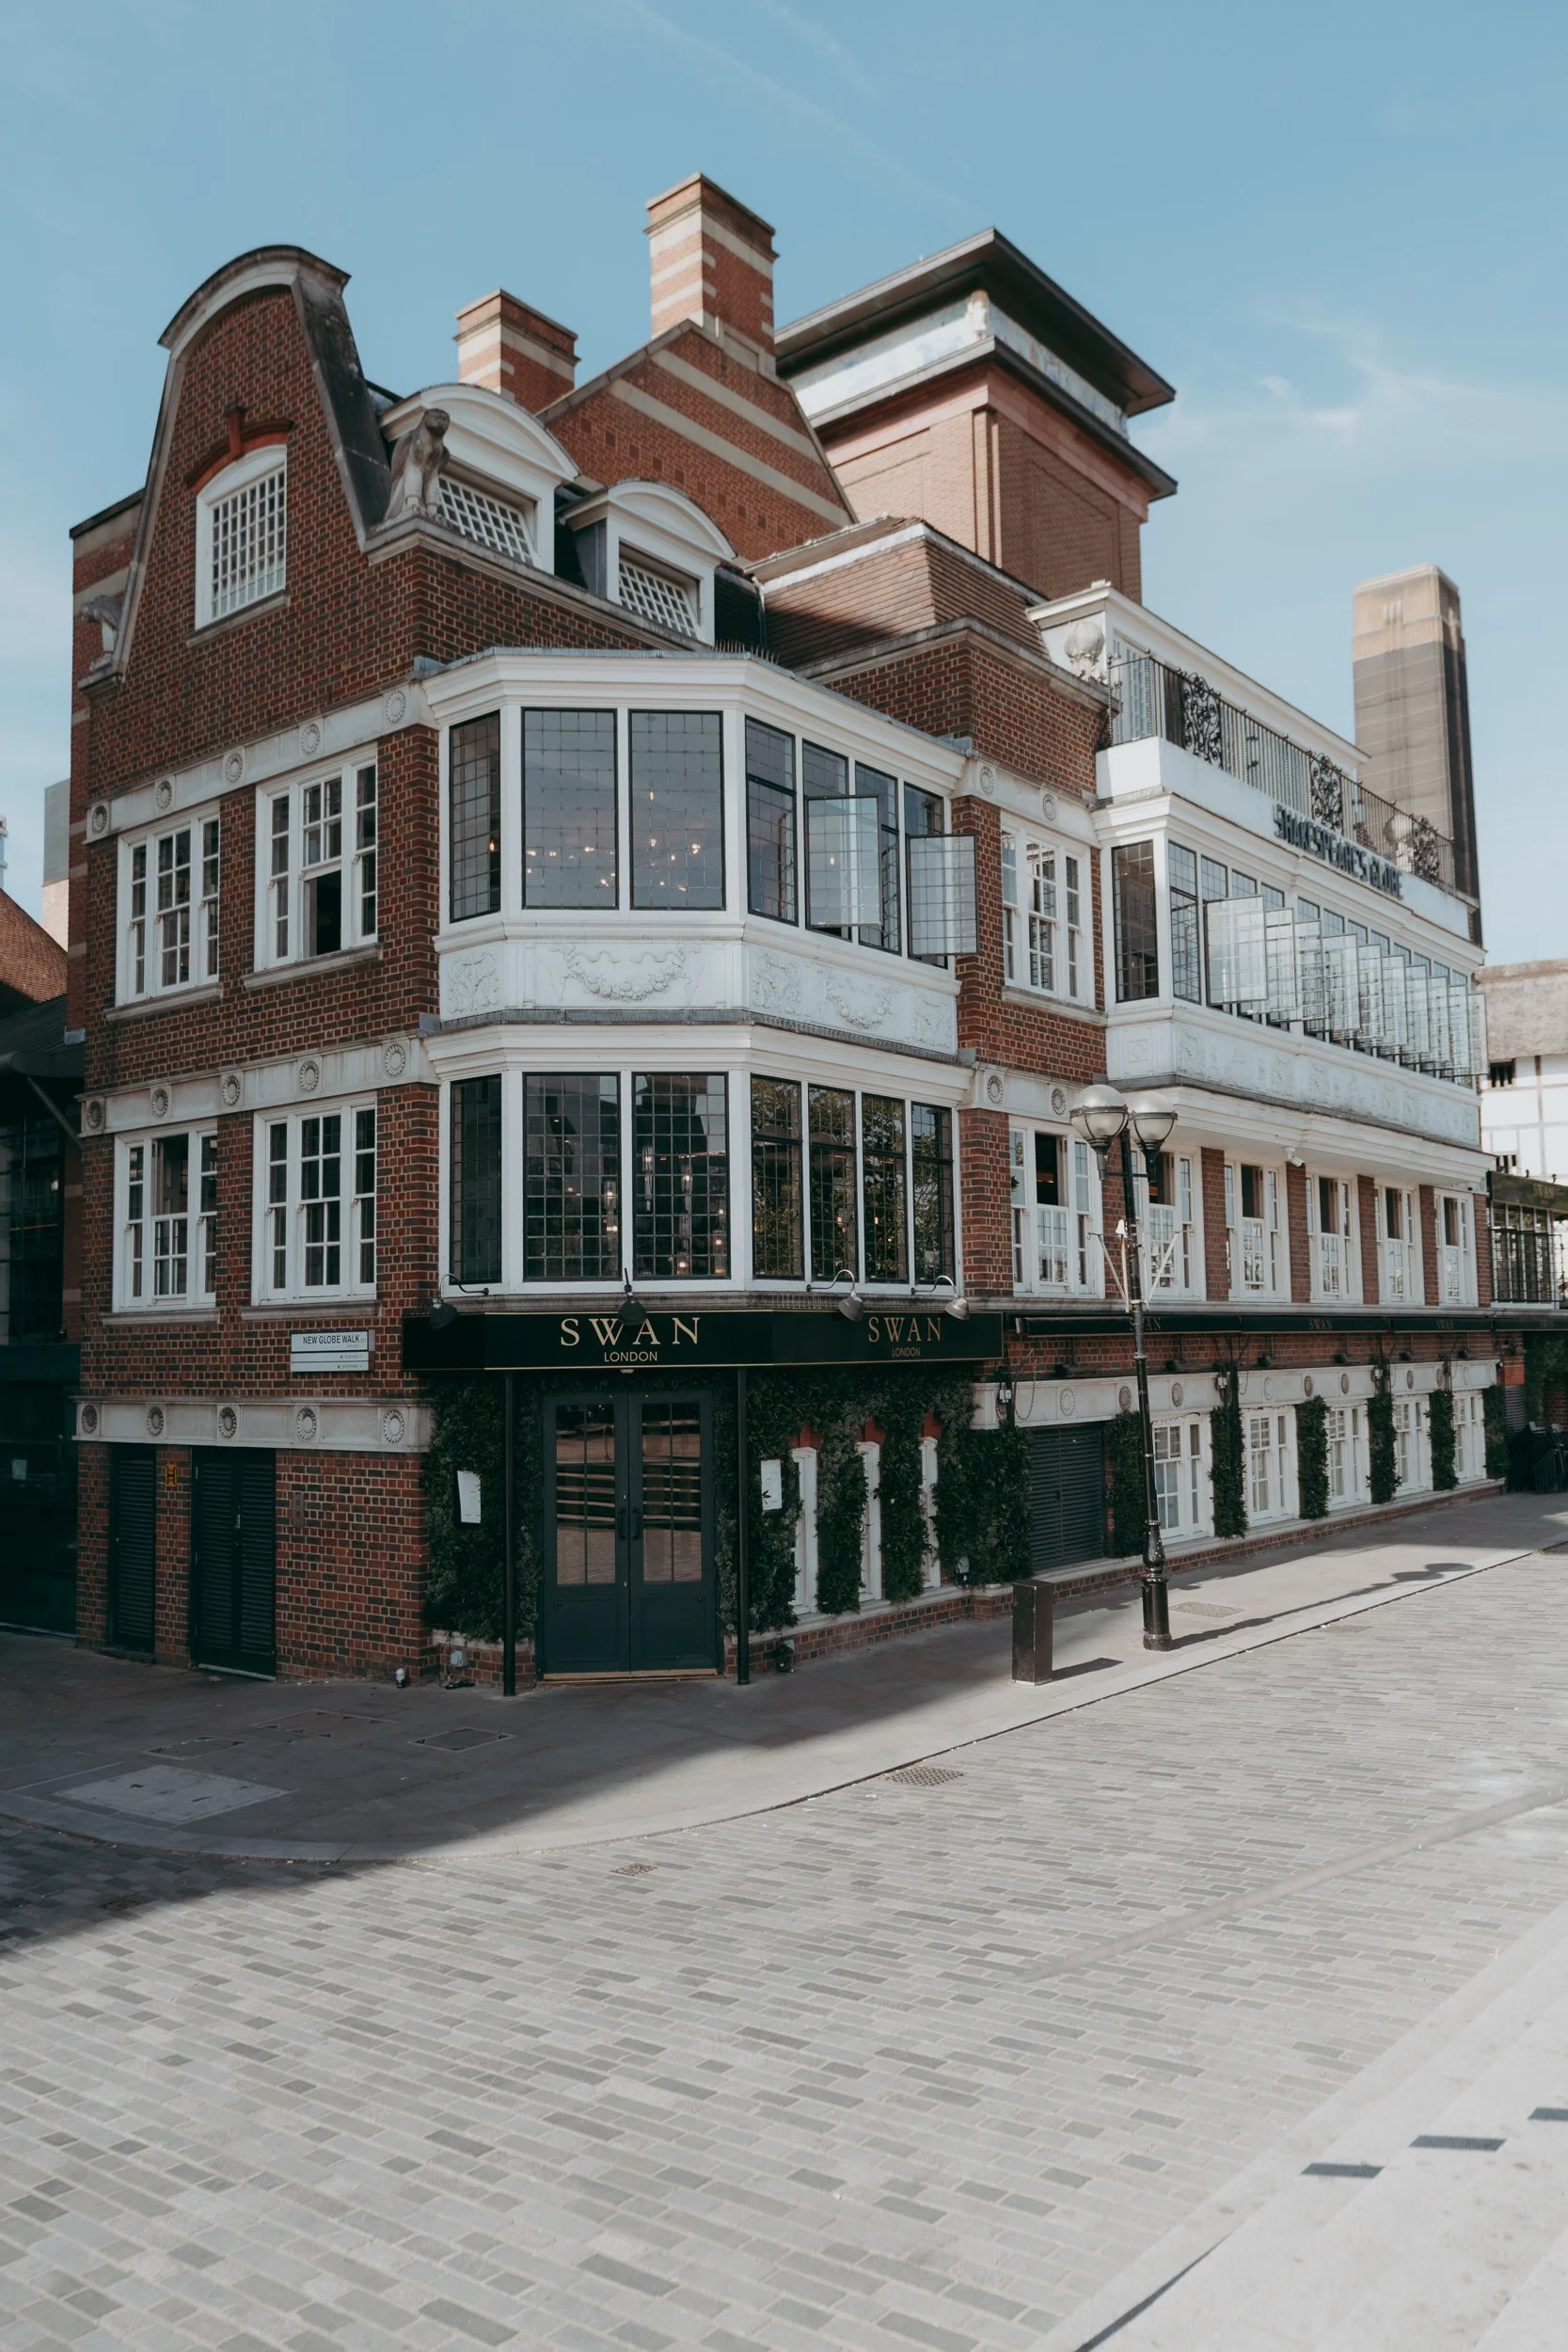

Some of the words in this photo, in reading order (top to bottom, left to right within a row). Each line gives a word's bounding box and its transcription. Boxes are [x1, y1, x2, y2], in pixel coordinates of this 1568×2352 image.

[868, 1316, 942, 1343] SWAN
[1129, 1317, 1162, 1331] SAN
[561, 1317, 701, 1346] SWAN
[303, 1336, 318, 1344] NEW
[319, 1335, 341, 1344] GLOBE
[342, 1334, 360, 1343] WALK
[604, 1351, 658, 1362] LONDON
[892, 1347, 921, 1358] LONDON
